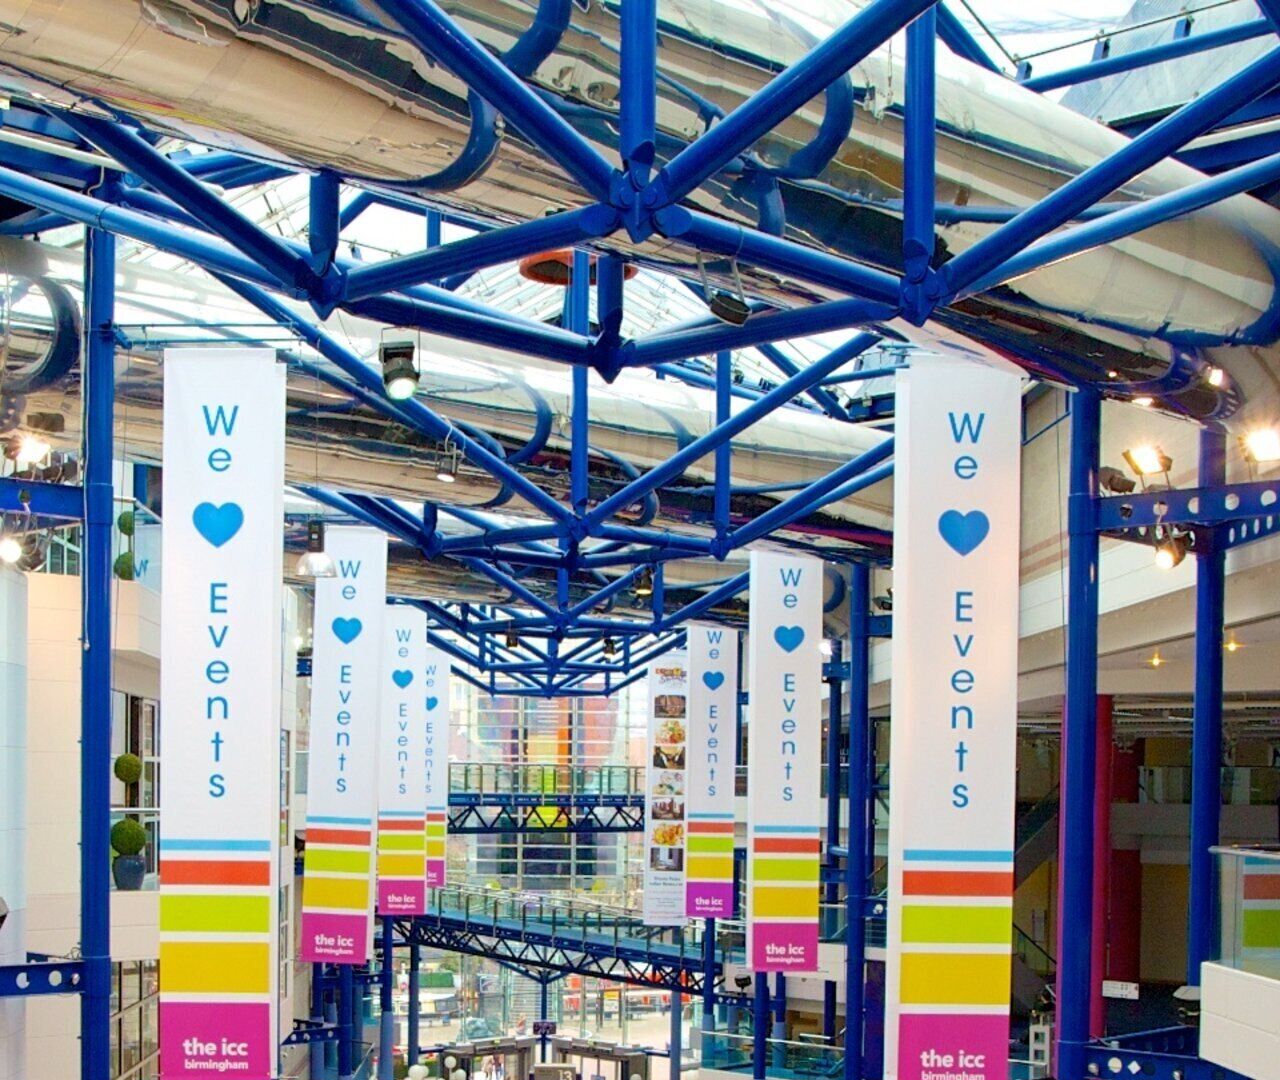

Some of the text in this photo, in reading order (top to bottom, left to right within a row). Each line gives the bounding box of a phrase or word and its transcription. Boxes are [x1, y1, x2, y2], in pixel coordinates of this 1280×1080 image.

[202, 405, 239, 797] We Events
[948, 412, 985, 808] We Events
[336, 560, 361, 793] We Events
[780, 568, 802, 802] We Events
[396, 629, 411, 795] We Events
[707, 630, 723, 797] We Events
[425, 722, 433, 794] Events
[387, 894, 416, 903] the icc
[695, 897, 723, 905] the icc
[315, 934, 354, 947] the icc
[765, 944, 804, 954] the icc
[315, 946, 354, 955] birmingham
[183, 1038, 247, 1055] the icc
[185, 1059, 248, 1071] birmingham
[921, 1050, 984, 1067] the icc
